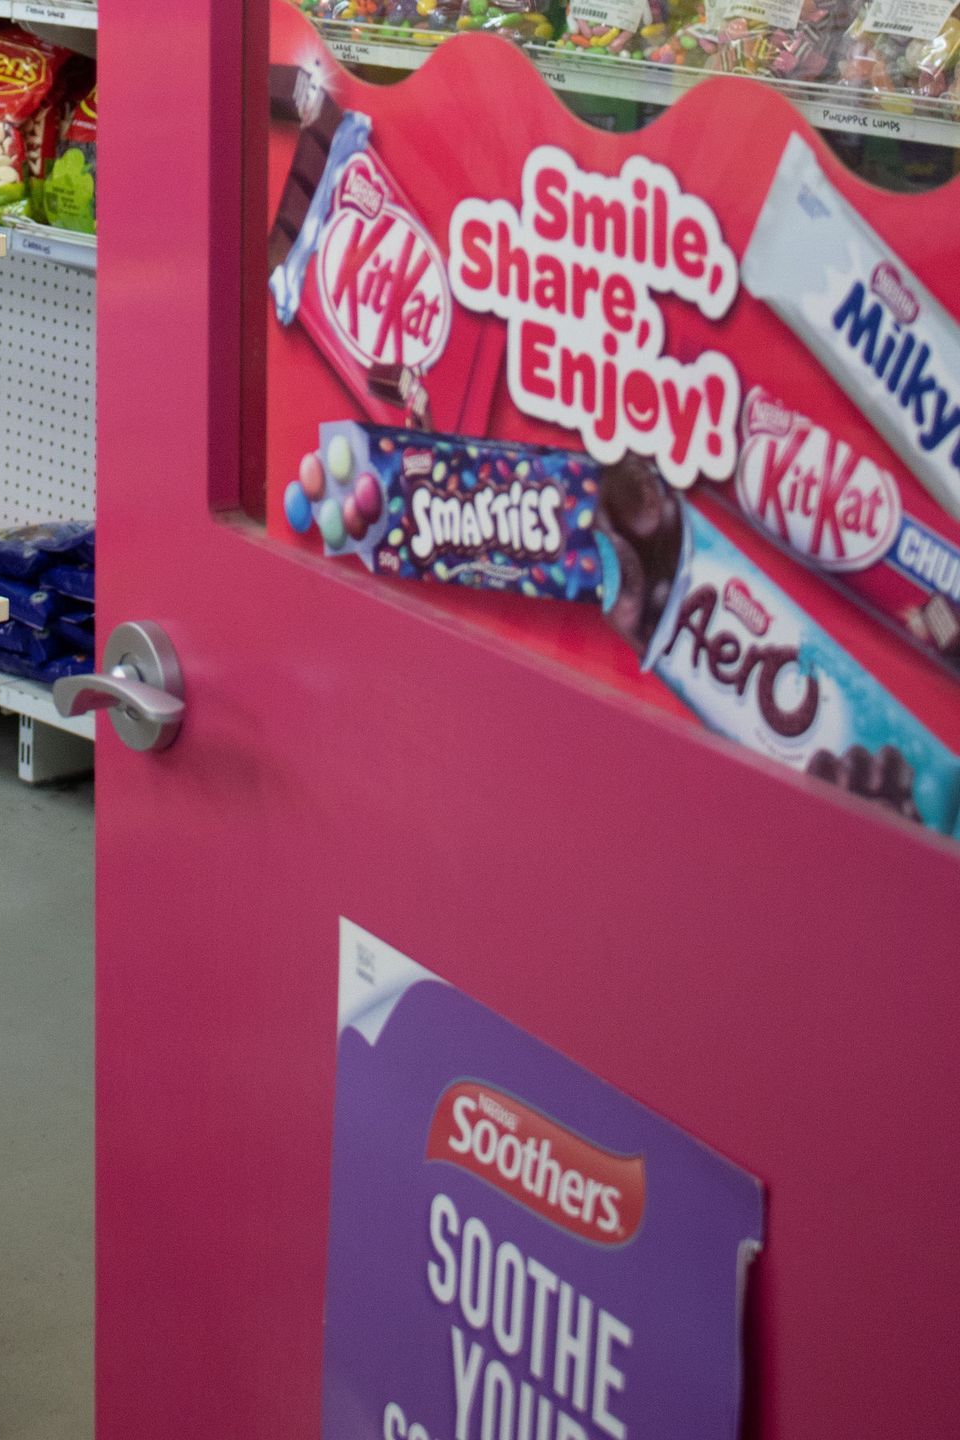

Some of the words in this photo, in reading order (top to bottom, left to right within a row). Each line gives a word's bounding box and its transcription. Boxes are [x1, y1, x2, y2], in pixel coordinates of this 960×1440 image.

[822, 110, 868, 128] PINEAPPLE
[872, 116, 902, 133] LUMPS
[331, 217, 441, 359] KitKat
[460, 219, 651, 350] Share,
[533, 167, 723, 296] Smile,
[520, 332, 725, 465] Enjoy!
[832, 281, 960, 468] Milky
[758, 424, 883, 559] KitKat
[447, 1094, 624, 1234] Soothers
[426, 1192, 634, 1439] SOOTHE
